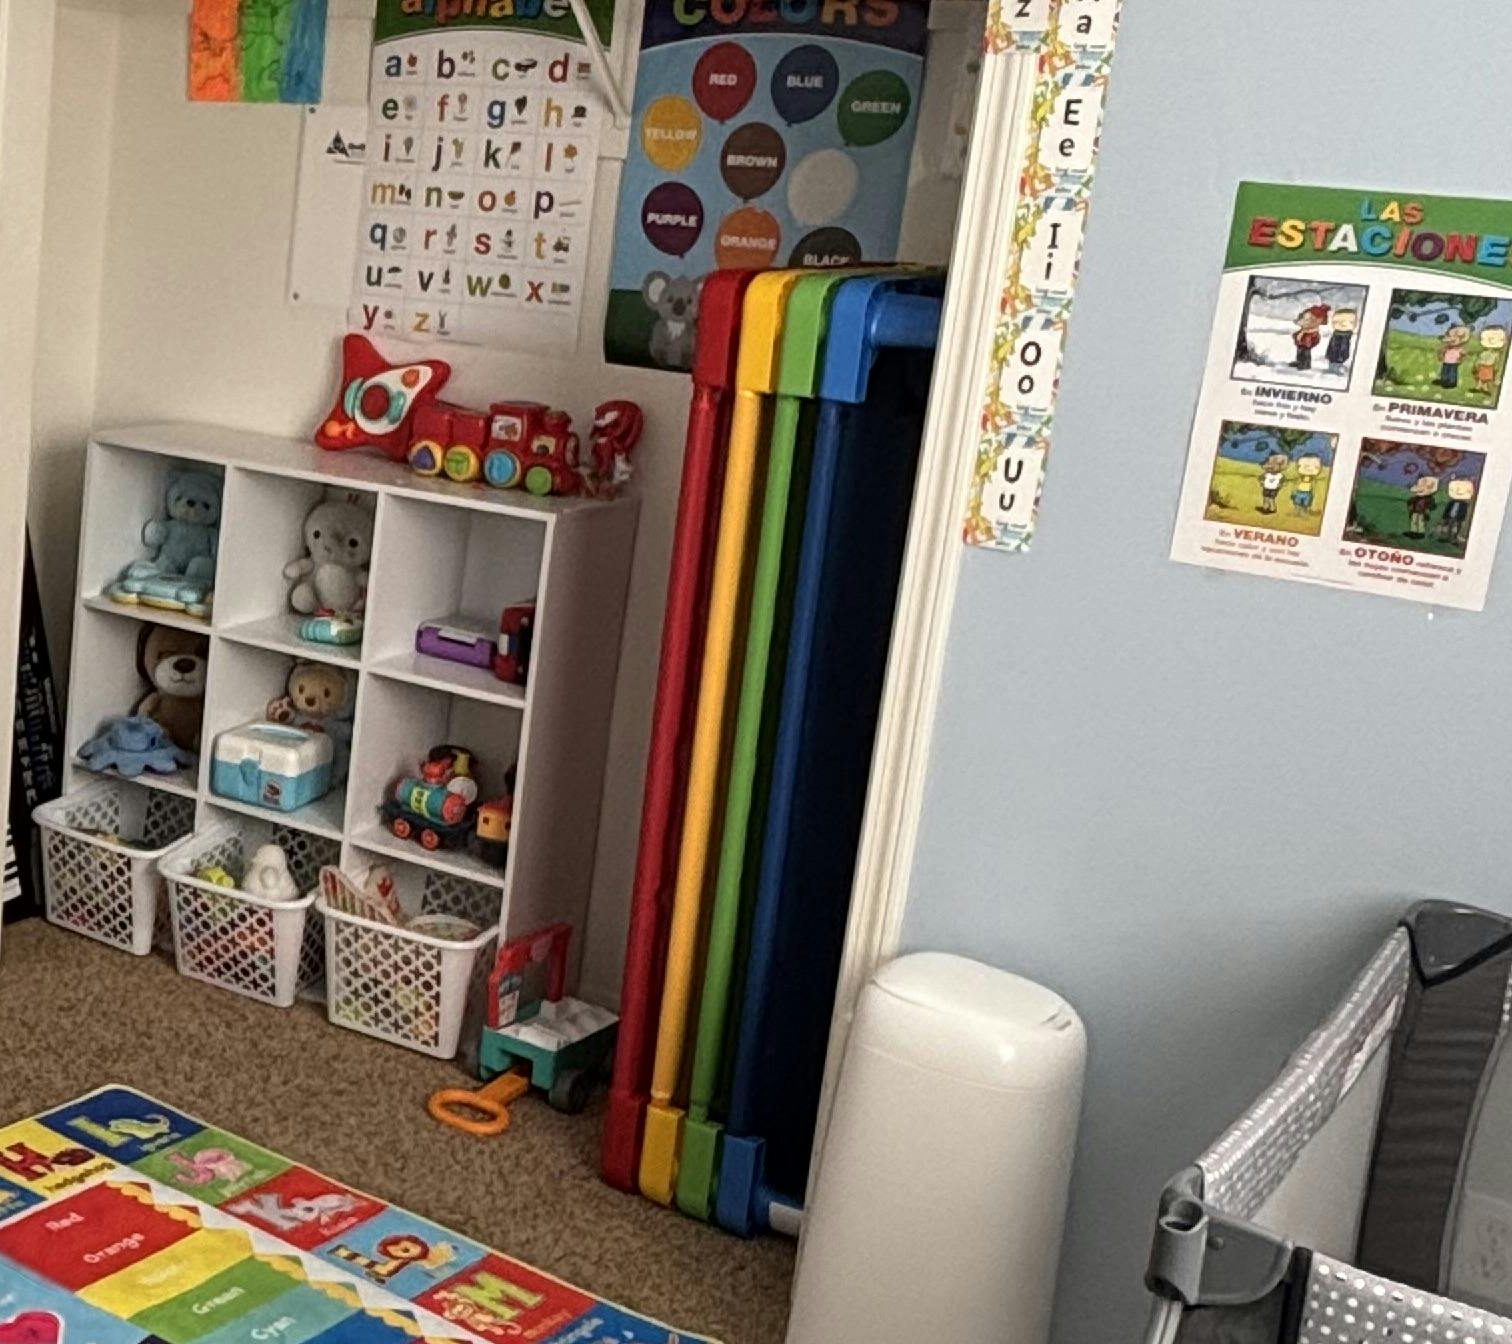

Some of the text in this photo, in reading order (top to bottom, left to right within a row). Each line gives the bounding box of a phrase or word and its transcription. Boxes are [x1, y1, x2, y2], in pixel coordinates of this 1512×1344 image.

[709, 73, 737, 86] RED
[786, 75, 824, 88] BLUE
[849, 100, 902, 114] GREEN
[644, 127, 698, 141] YELLOW
[726, 155, 778, 168] BROWN
[646, 213, 698, 228] PURPLE
[1360, 197, 1424, 225] LAS
[720, 235, 777, 249] ORANGE
[1248, 216, 1512, 266] ESTACIONE
[1254, 386, 1333, 404] INVIERNO
[1388, 402, 1488, 424] PRIMAVERA
[1232, 528, 1300, 548] VERANO
[1354, 546, 1414, 566] OTOÑO
[44, 1211, 85, 1232] Red
[82, 1232, 145, 1264] Orange
[191, 1285, 246, 1316] Green
[250, 1314, 297, 1342] Cyan
